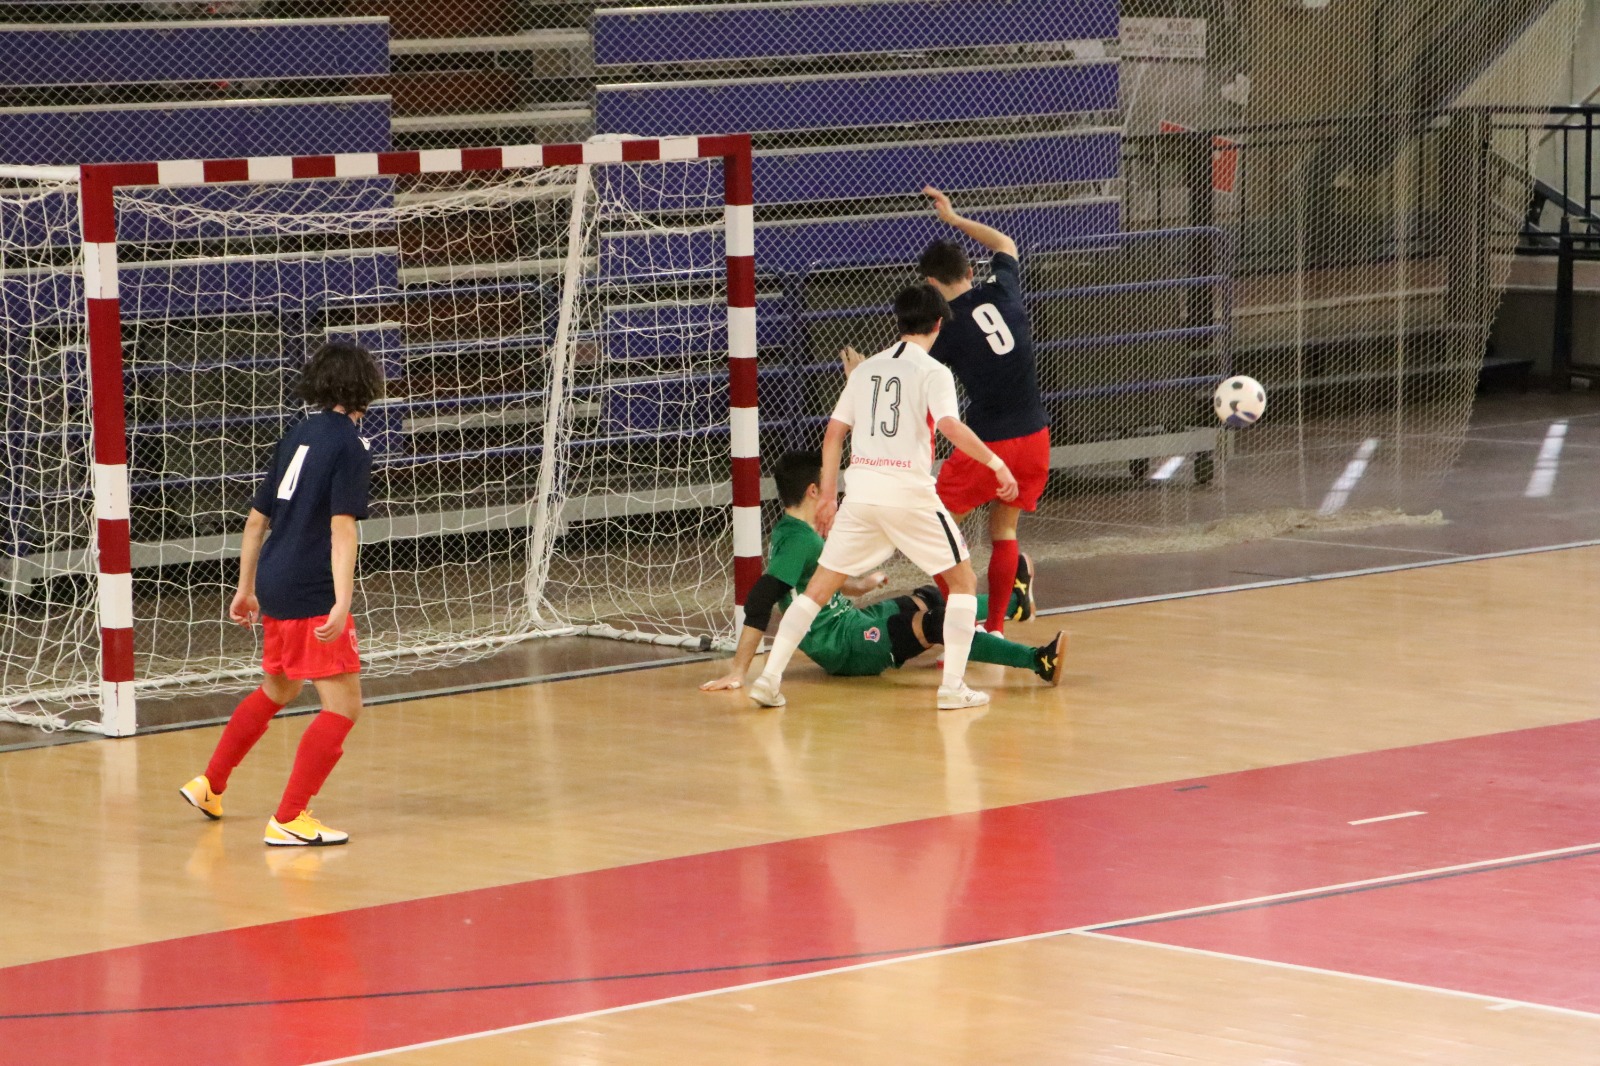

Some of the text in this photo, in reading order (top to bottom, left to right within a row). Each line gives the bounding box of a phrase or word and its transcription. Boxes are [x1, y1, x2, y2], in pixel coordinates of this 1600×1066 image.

[971, 302, 1015, 355] 9
[871, 375, 901, 437] 13
[276, 444, 310, 501] 4
